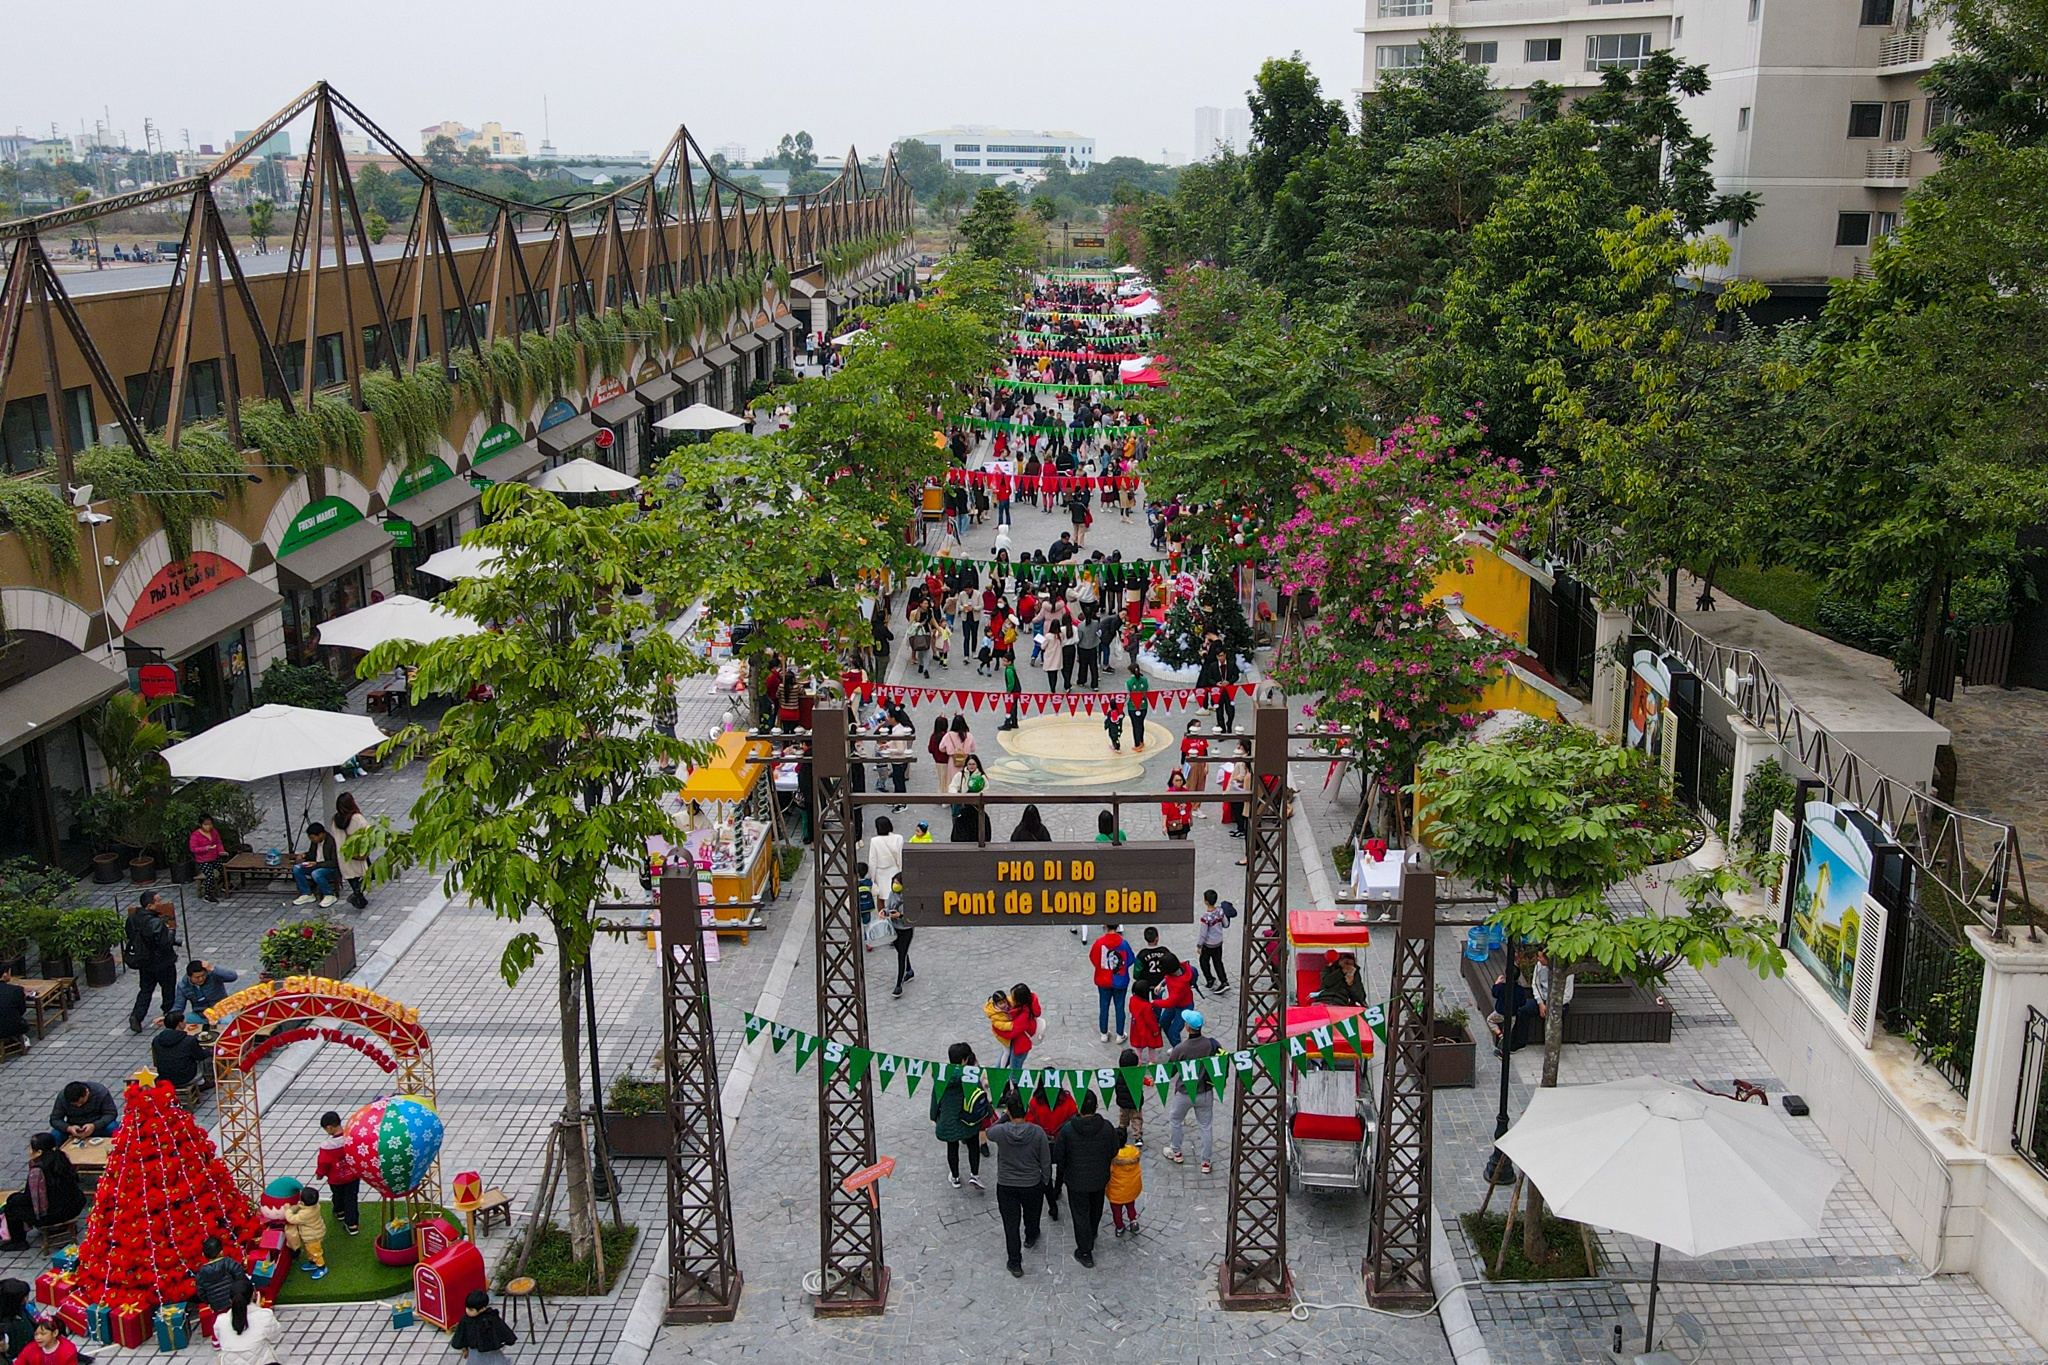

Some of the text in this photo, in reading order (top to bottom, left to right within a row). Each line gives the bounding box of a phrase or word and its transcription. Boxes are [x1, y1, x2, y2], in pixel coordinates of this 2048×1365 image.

[298, 516, 316, 532] FRESH
[316, 506, 337, 524] MARKET
[877, 686, 952, 697] MERRY
[989, 693, 1127, 704] CHRISTMAS
[997, 860, 1095, 881] PHO DI BO
[943, 888, 1157, 916] Pont de Long Bien
[203, 975, 420, 1025] MERRY CHRISTMAS
[745, 1005, 1385, 1088] AMIS AMIS AMIS AMIS AMIS
